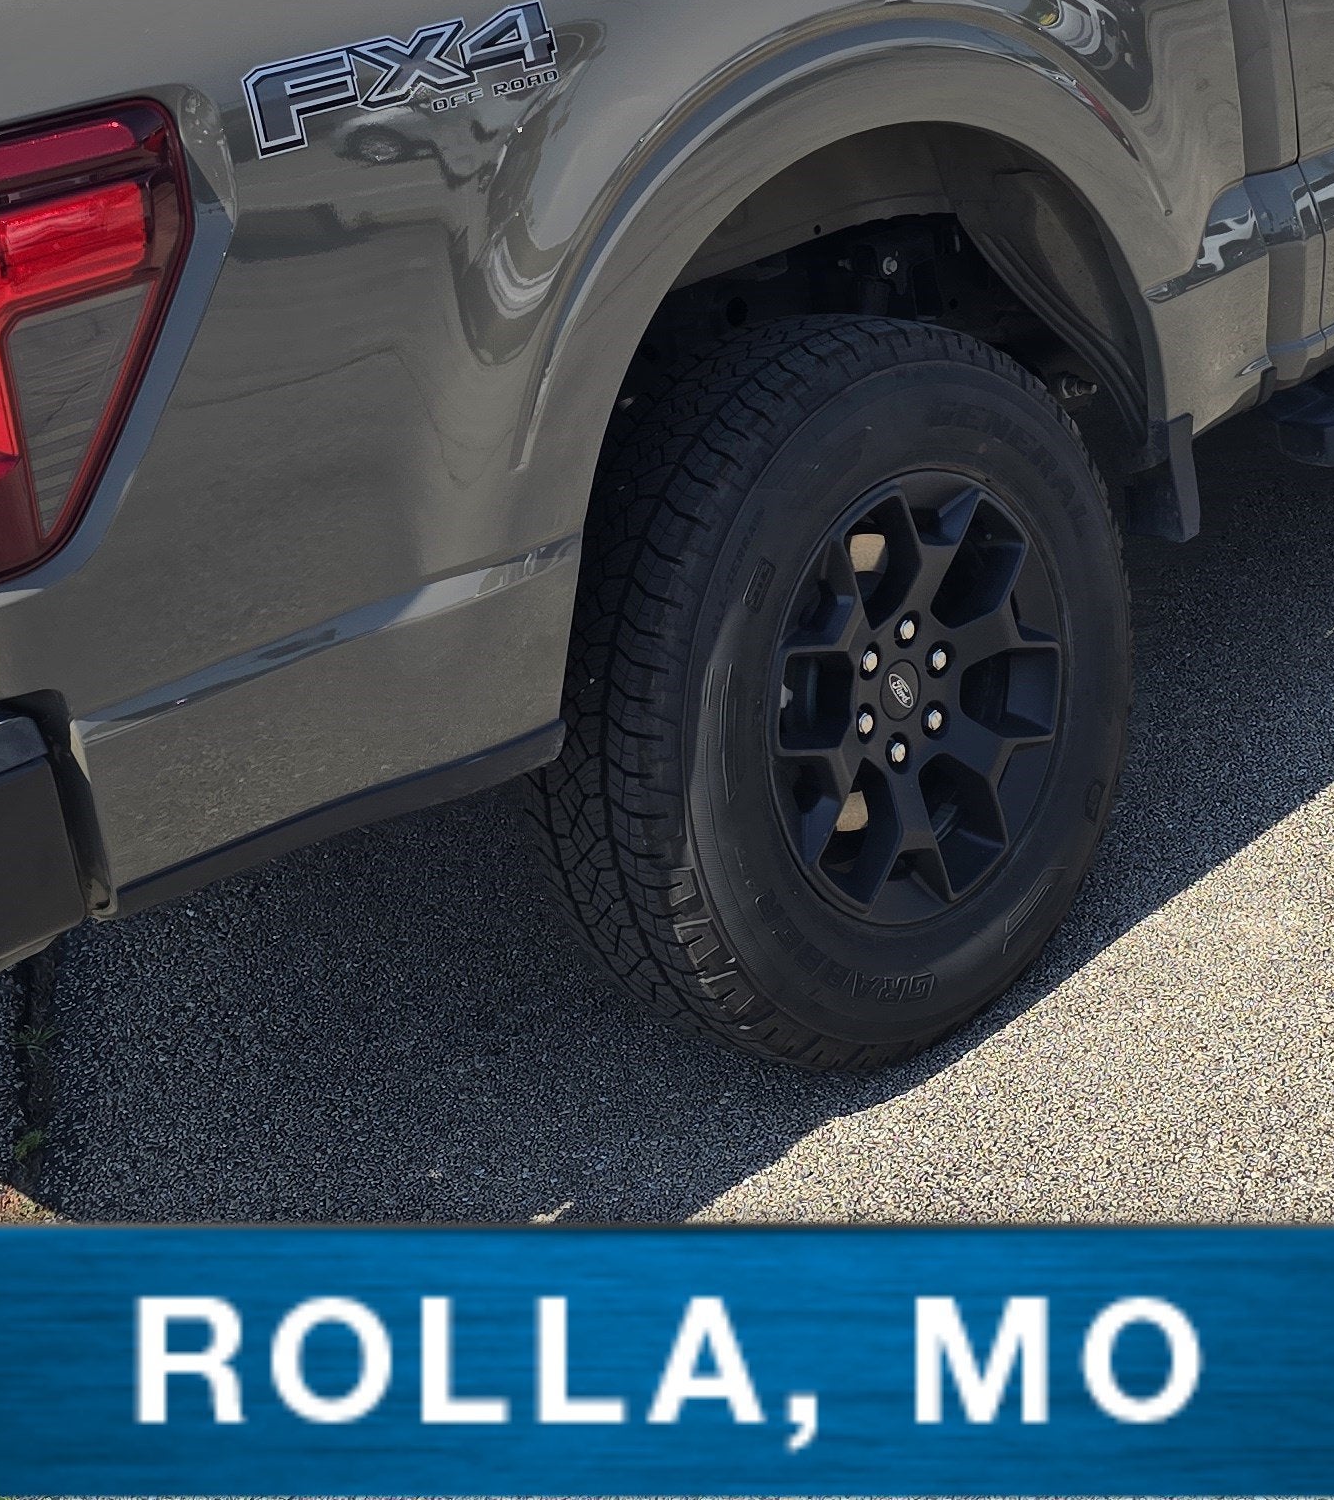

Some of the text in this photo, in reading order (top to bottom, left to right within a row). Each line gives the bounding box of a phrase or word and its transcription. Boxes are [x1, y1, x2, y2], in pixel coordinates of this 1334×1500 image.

[241, 0, 558, 159] FX4
[432, 70, 559, 112] OFF ROAD
